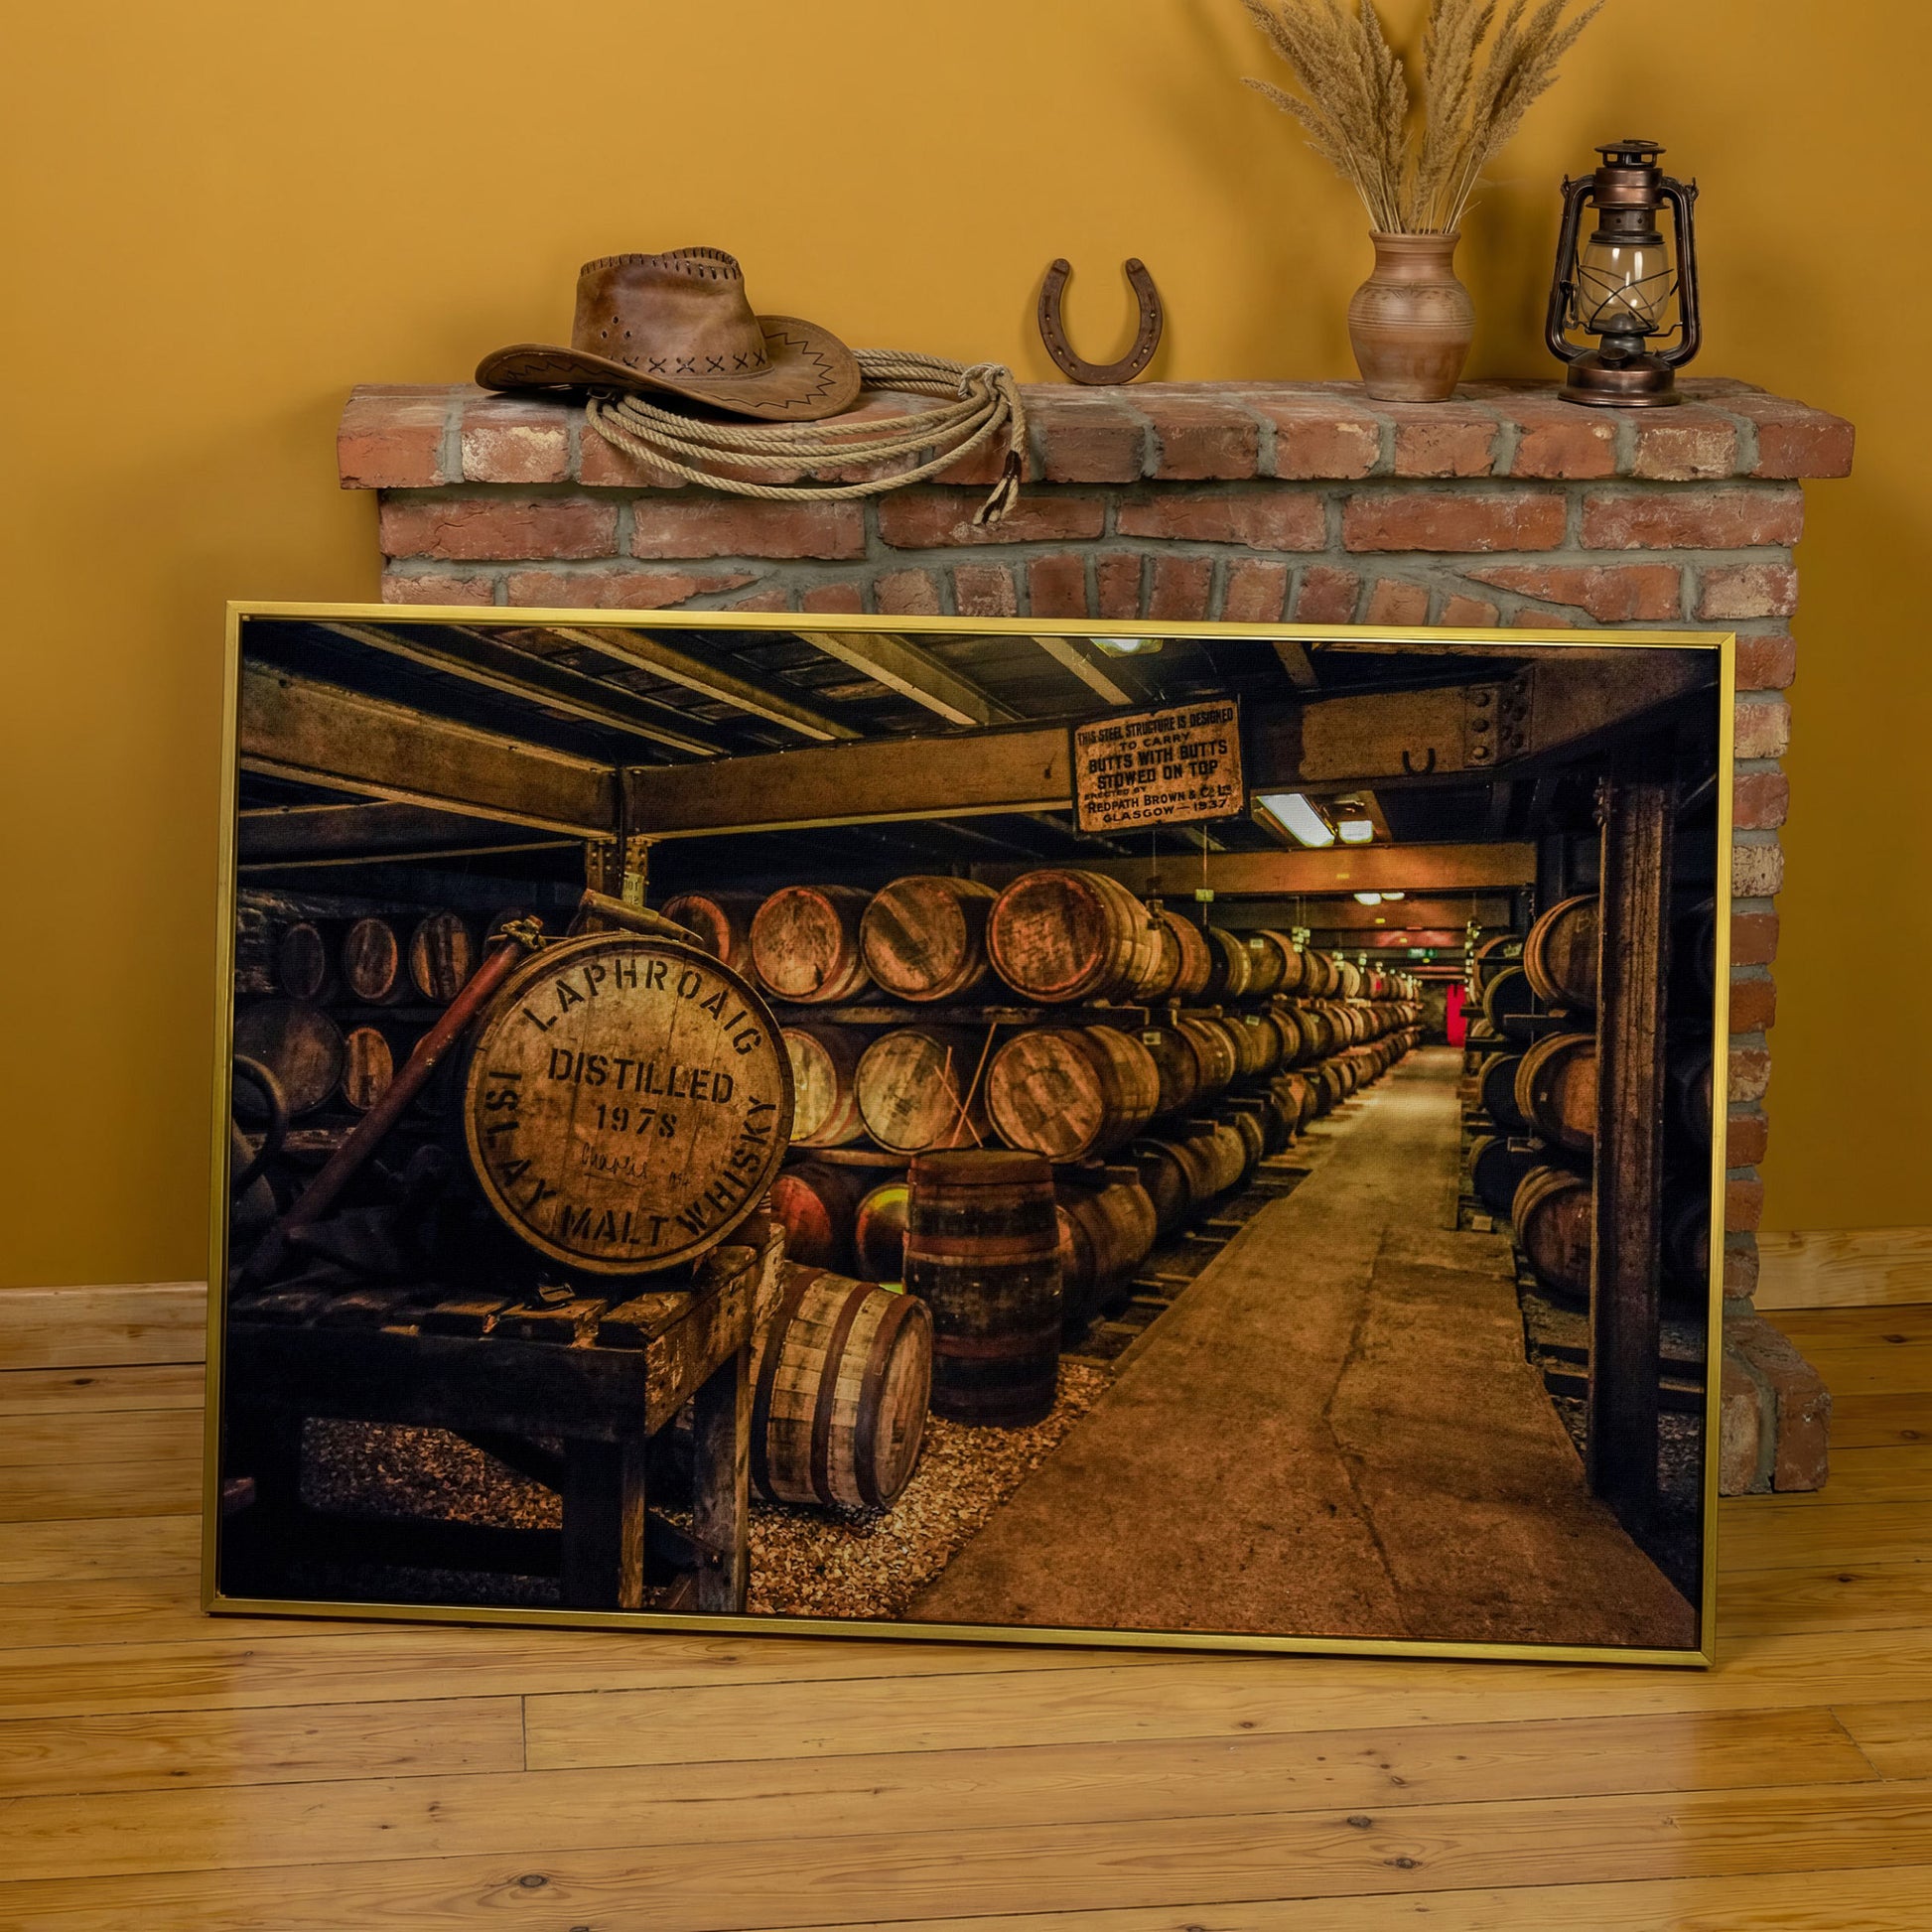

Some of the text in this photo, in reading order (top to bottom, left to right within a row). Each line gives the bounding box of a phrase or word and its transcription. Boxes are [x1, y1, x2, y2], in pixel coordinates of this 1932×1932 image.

[1076, 706, 1234, 747] THIS STEEL STRUCTURE IS DESIGNED
[1119, 731, 1190, 752] TO CARRY
[1087, 739, 1228, 774] BUTTS WITH BUTTS
[1097, 759, 1219, 790] STOWED ON TOP
[1084, 785, 1148, 801] ERECTED BY
[1087, 796, 1140, 814] REDPATH
[1143, 790, 1186, 807] BROWN
[1188, 789, 1196, 800] &
[1102, 806, 1174, 823] GLASGOW
[521, 959, 761, 1055] LAPHROAIG
[548, 1047, 734, 1104] DISTILLED
[596, 1104, 678, 1139] 1978
[484, 1071, 776, 1247] ISLAY MALT WHISKY
